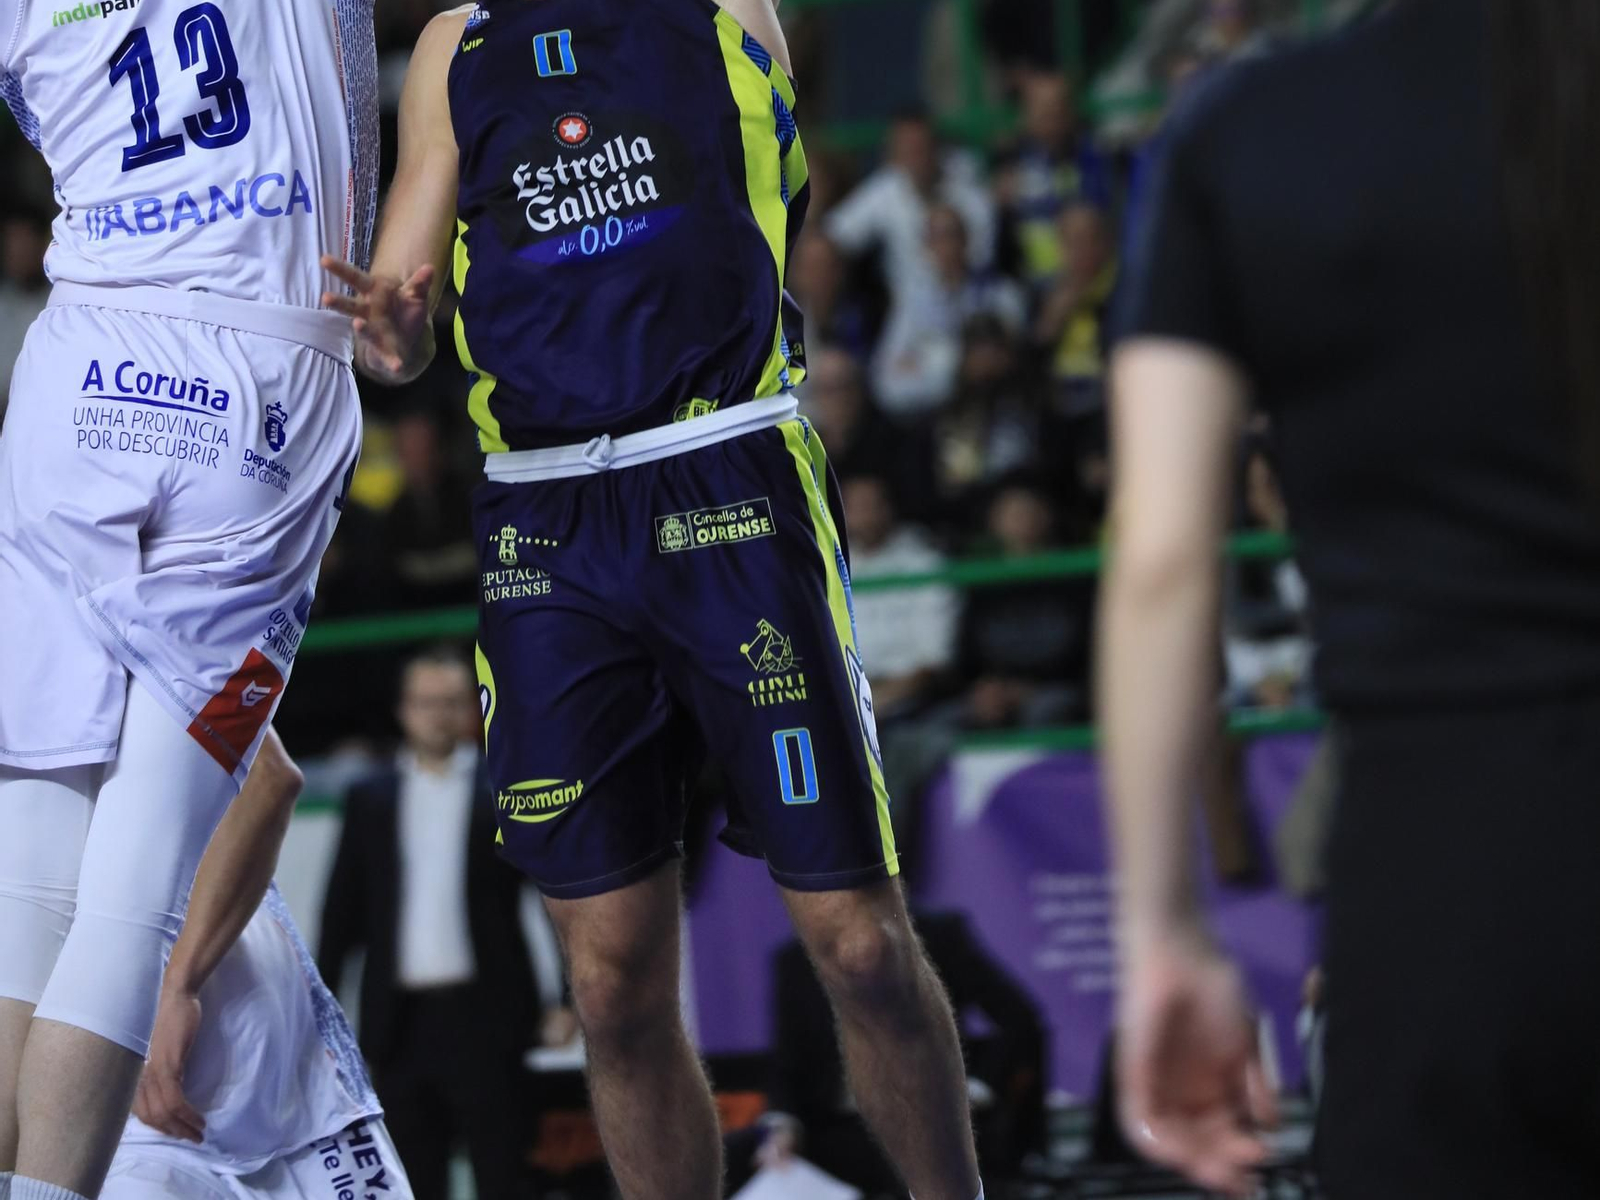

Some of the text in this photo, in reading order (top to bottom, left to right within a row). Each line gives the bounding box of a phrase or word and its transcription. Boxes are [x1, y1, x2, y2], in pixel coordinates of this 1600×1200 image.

[532, 28, 577, 77] 0
[109, 1, 250, 173] 13
[512, 134, 656, 201] Estrella
[86, 169, 312, 241] ABANCA
[526, 172, 660, 232] Galicia
[580, 215, 623, 255] 0,0
[81, 360, 230, 411] A Coruña
[74, 407, 229, 447] UNHA PROVINCIA
[77, 429, 220, 469] POR DESCUBRIR
[244, 449, 291, 481] Deputación
[240, 464, 288, 494] DA CORUÑA
[696, 517, 771, 543] OURENSE
[740, 505, 754, 518] de
[485, 580, 551, 603] OURENSE
[772, 727, 819, 805] 0
[499, 779, 583, 815] tripomant
[319, 1139, 342, 1171] Te
